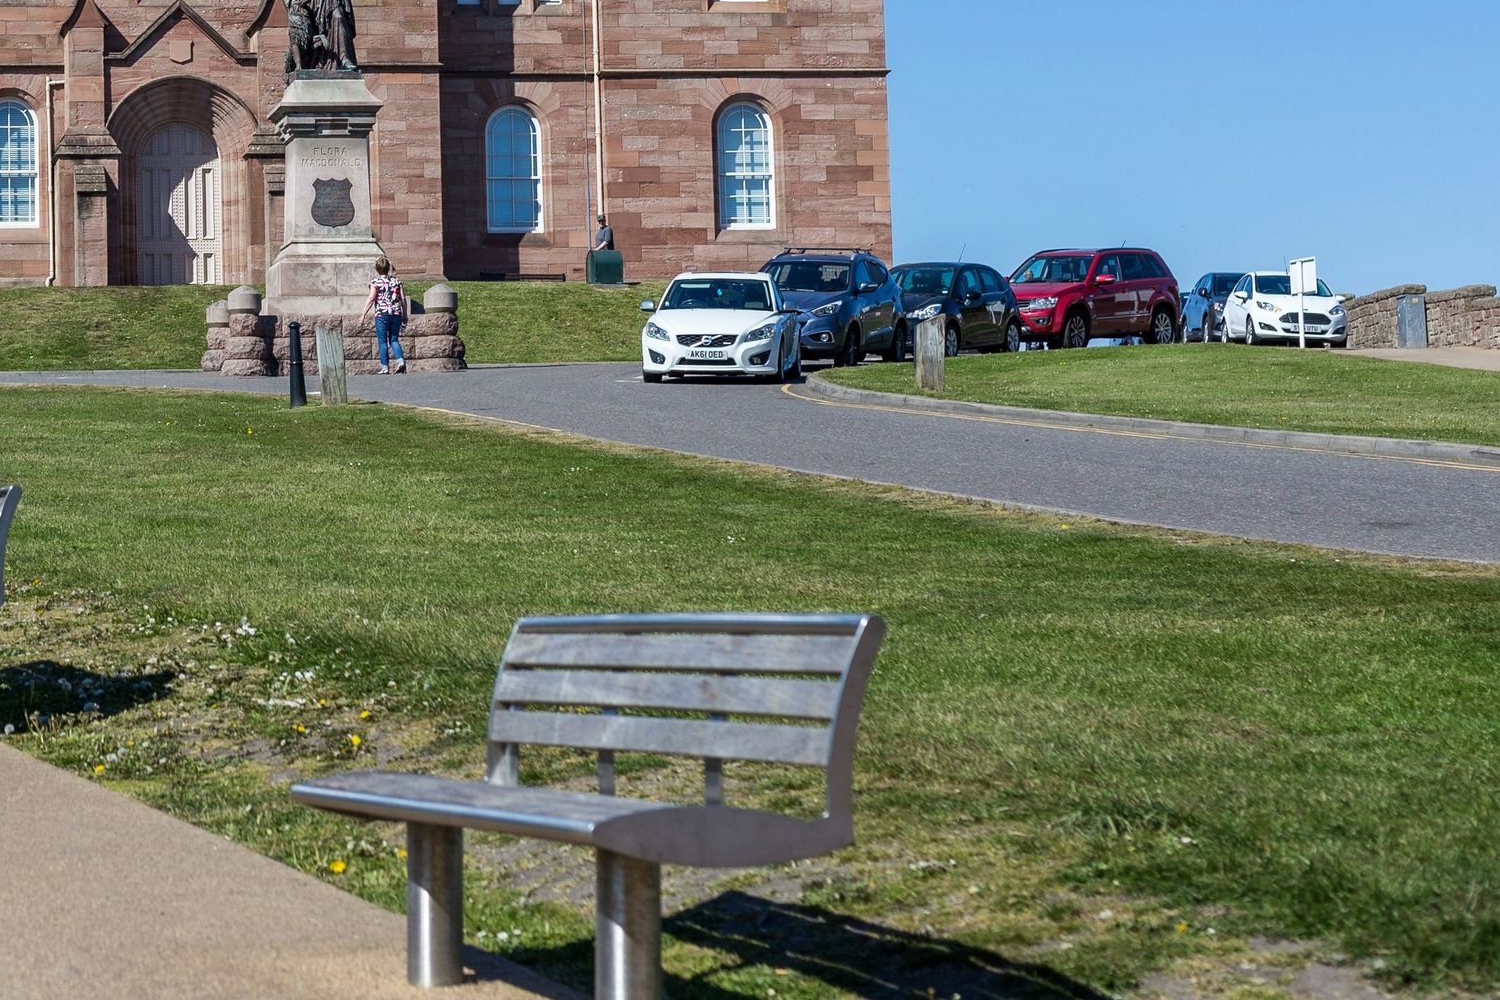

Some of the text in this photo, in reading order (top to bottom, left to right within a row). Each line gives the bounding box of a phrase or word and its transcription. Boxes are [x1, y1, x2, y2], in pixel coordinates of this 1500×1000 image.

[313, 147, 347, 156] FLORA
[301, 158, 362, 167] MACDONALD
[690, 350, 724, 358] AK61 OED
